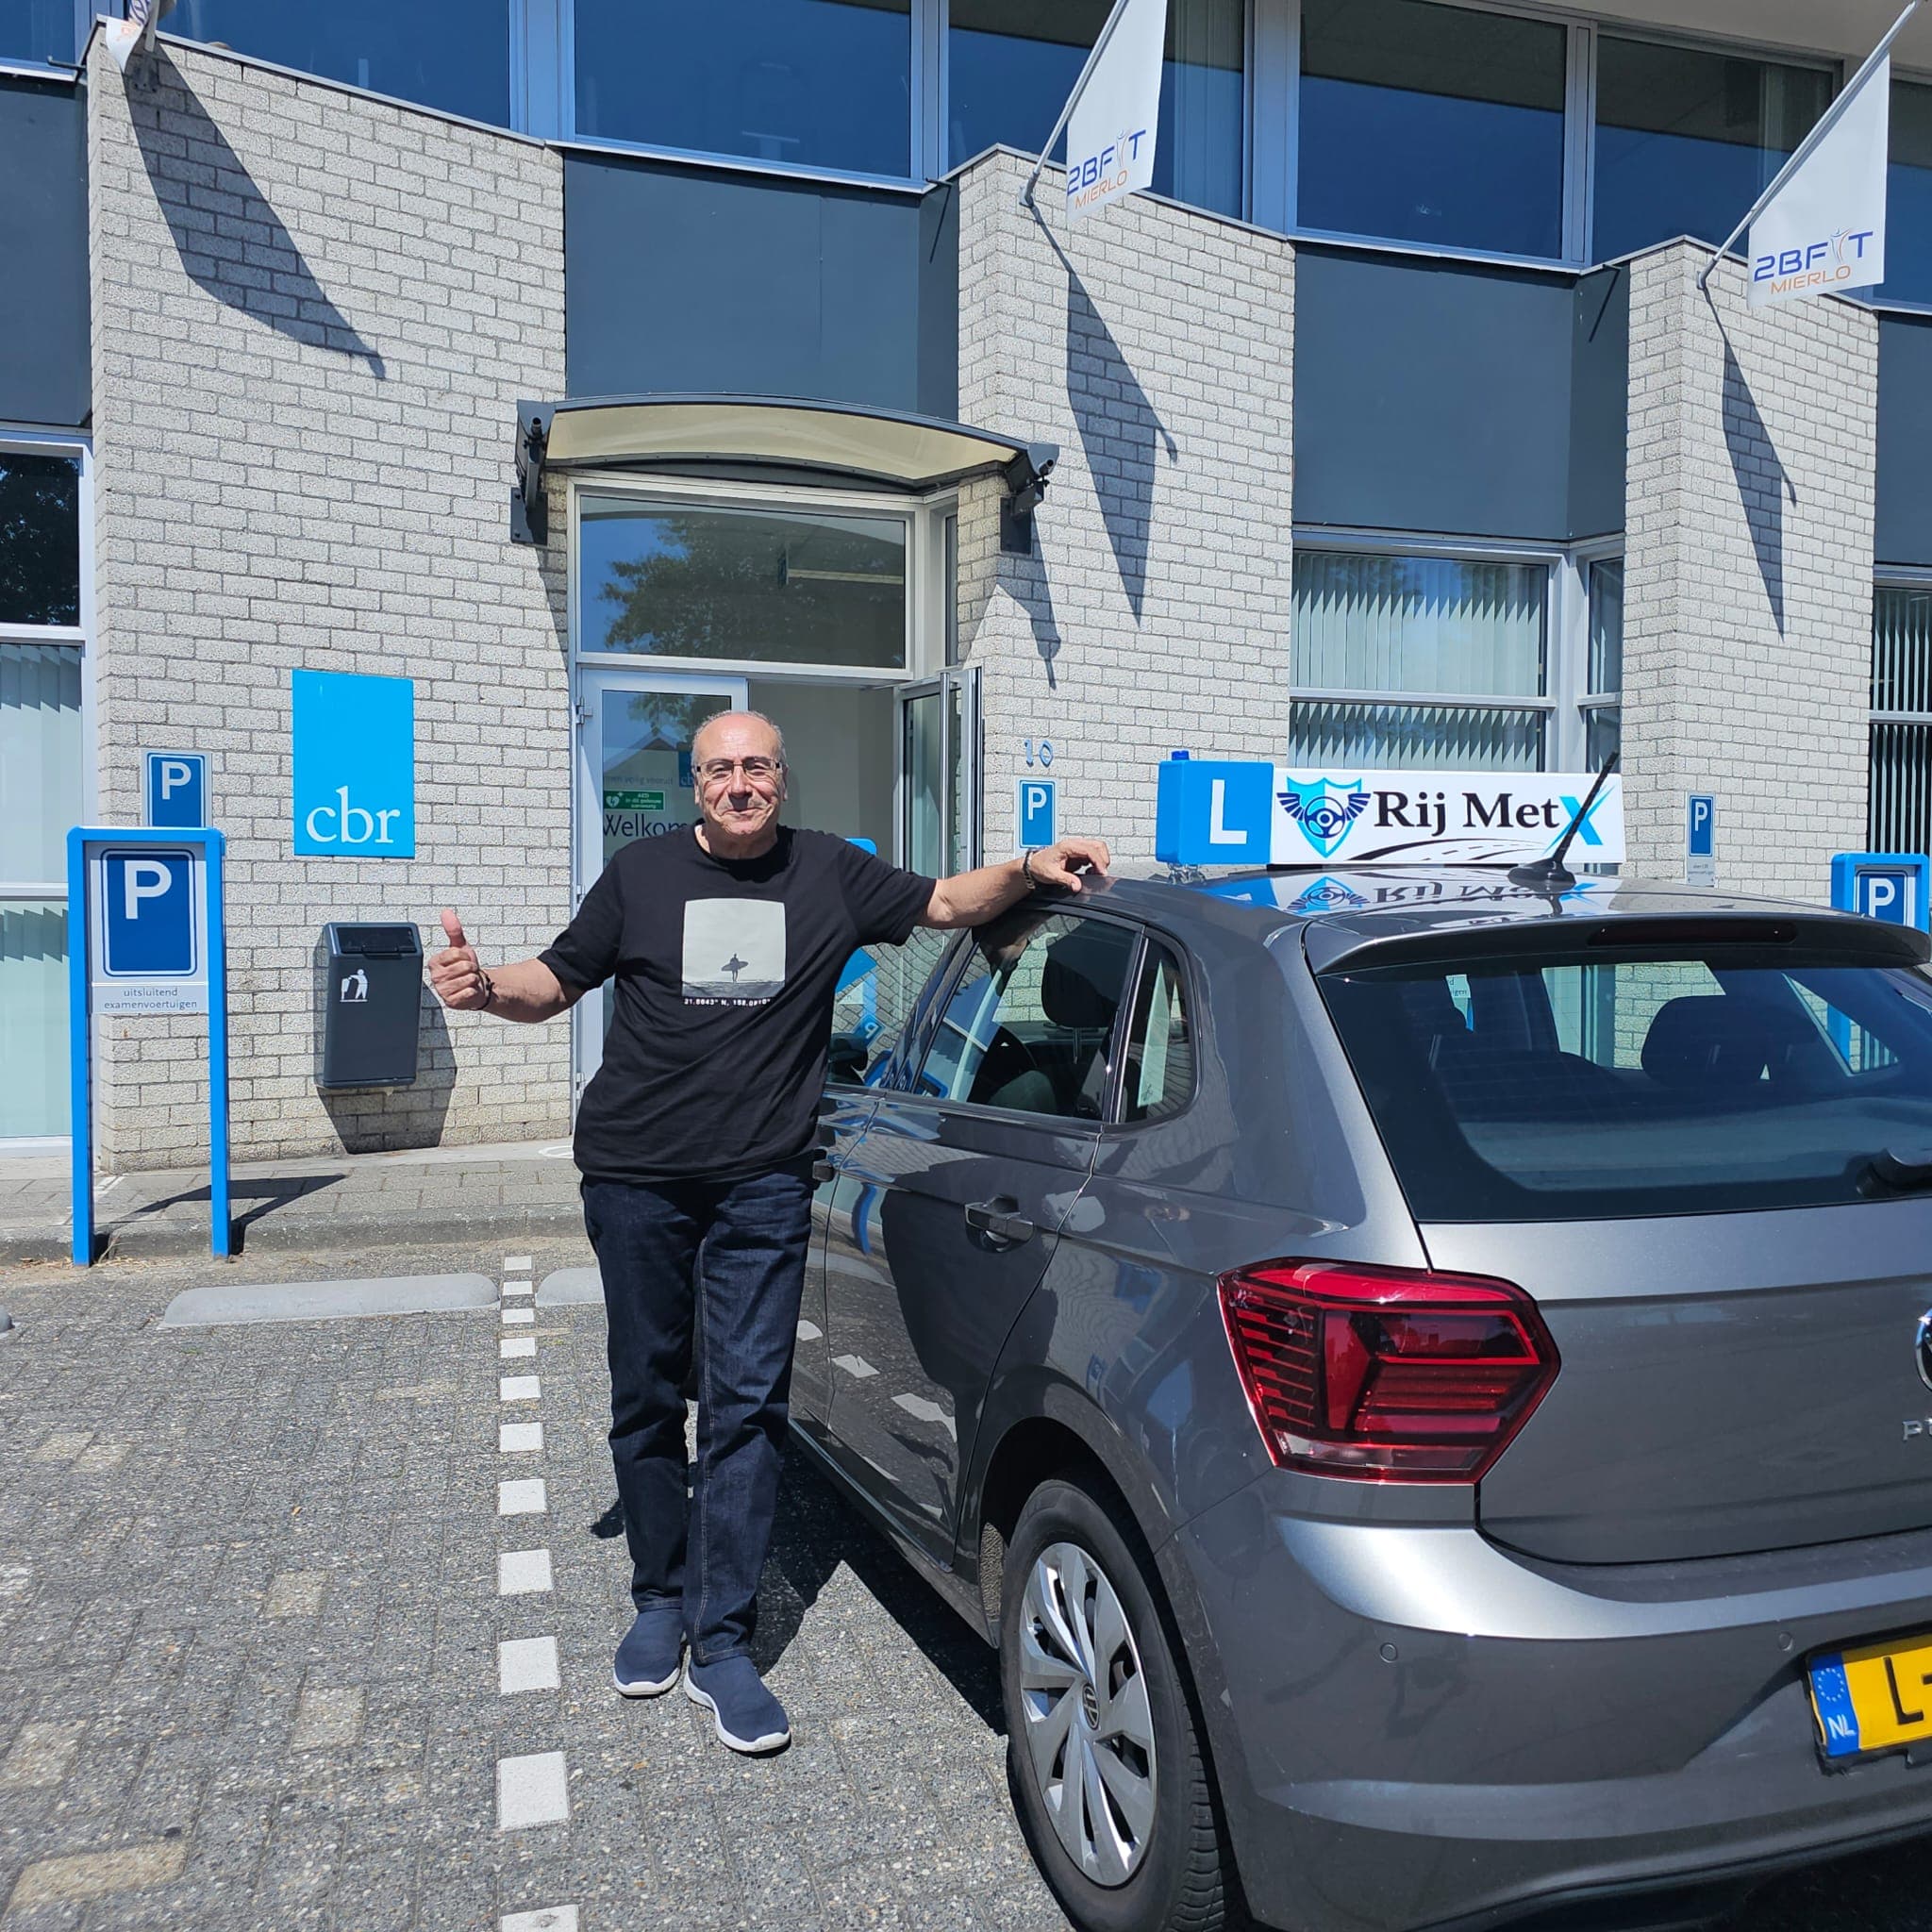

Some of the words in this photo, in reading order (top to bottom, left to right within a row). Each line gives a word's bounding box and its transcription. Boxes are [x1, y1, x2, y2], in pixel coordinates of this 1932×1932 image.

[1074, 169, 1128, 209] MIERLO
[1770, 264, 1852, 295] MIERLO
[1024, 739, 1055, 768] 10
[160, 760, 192, 801] P
[680, 773, 695, 787] cb
[306, 785, 401, 844] cbr
[1027, 786, 1048, 821] P
[1209, 778, 1248, 845] L
[1373, 791, 1446, 838] Rij
[1694, 801, 1708, 832] P
[123, 859, 173, 920] P
[1869, 877, 1895, 919] P
[104, 1000, 197, 1011] examenvoertuigen
[123, 987, 178, 997] uitsluitend
[1827, 1713, 1856, 1740] NL
